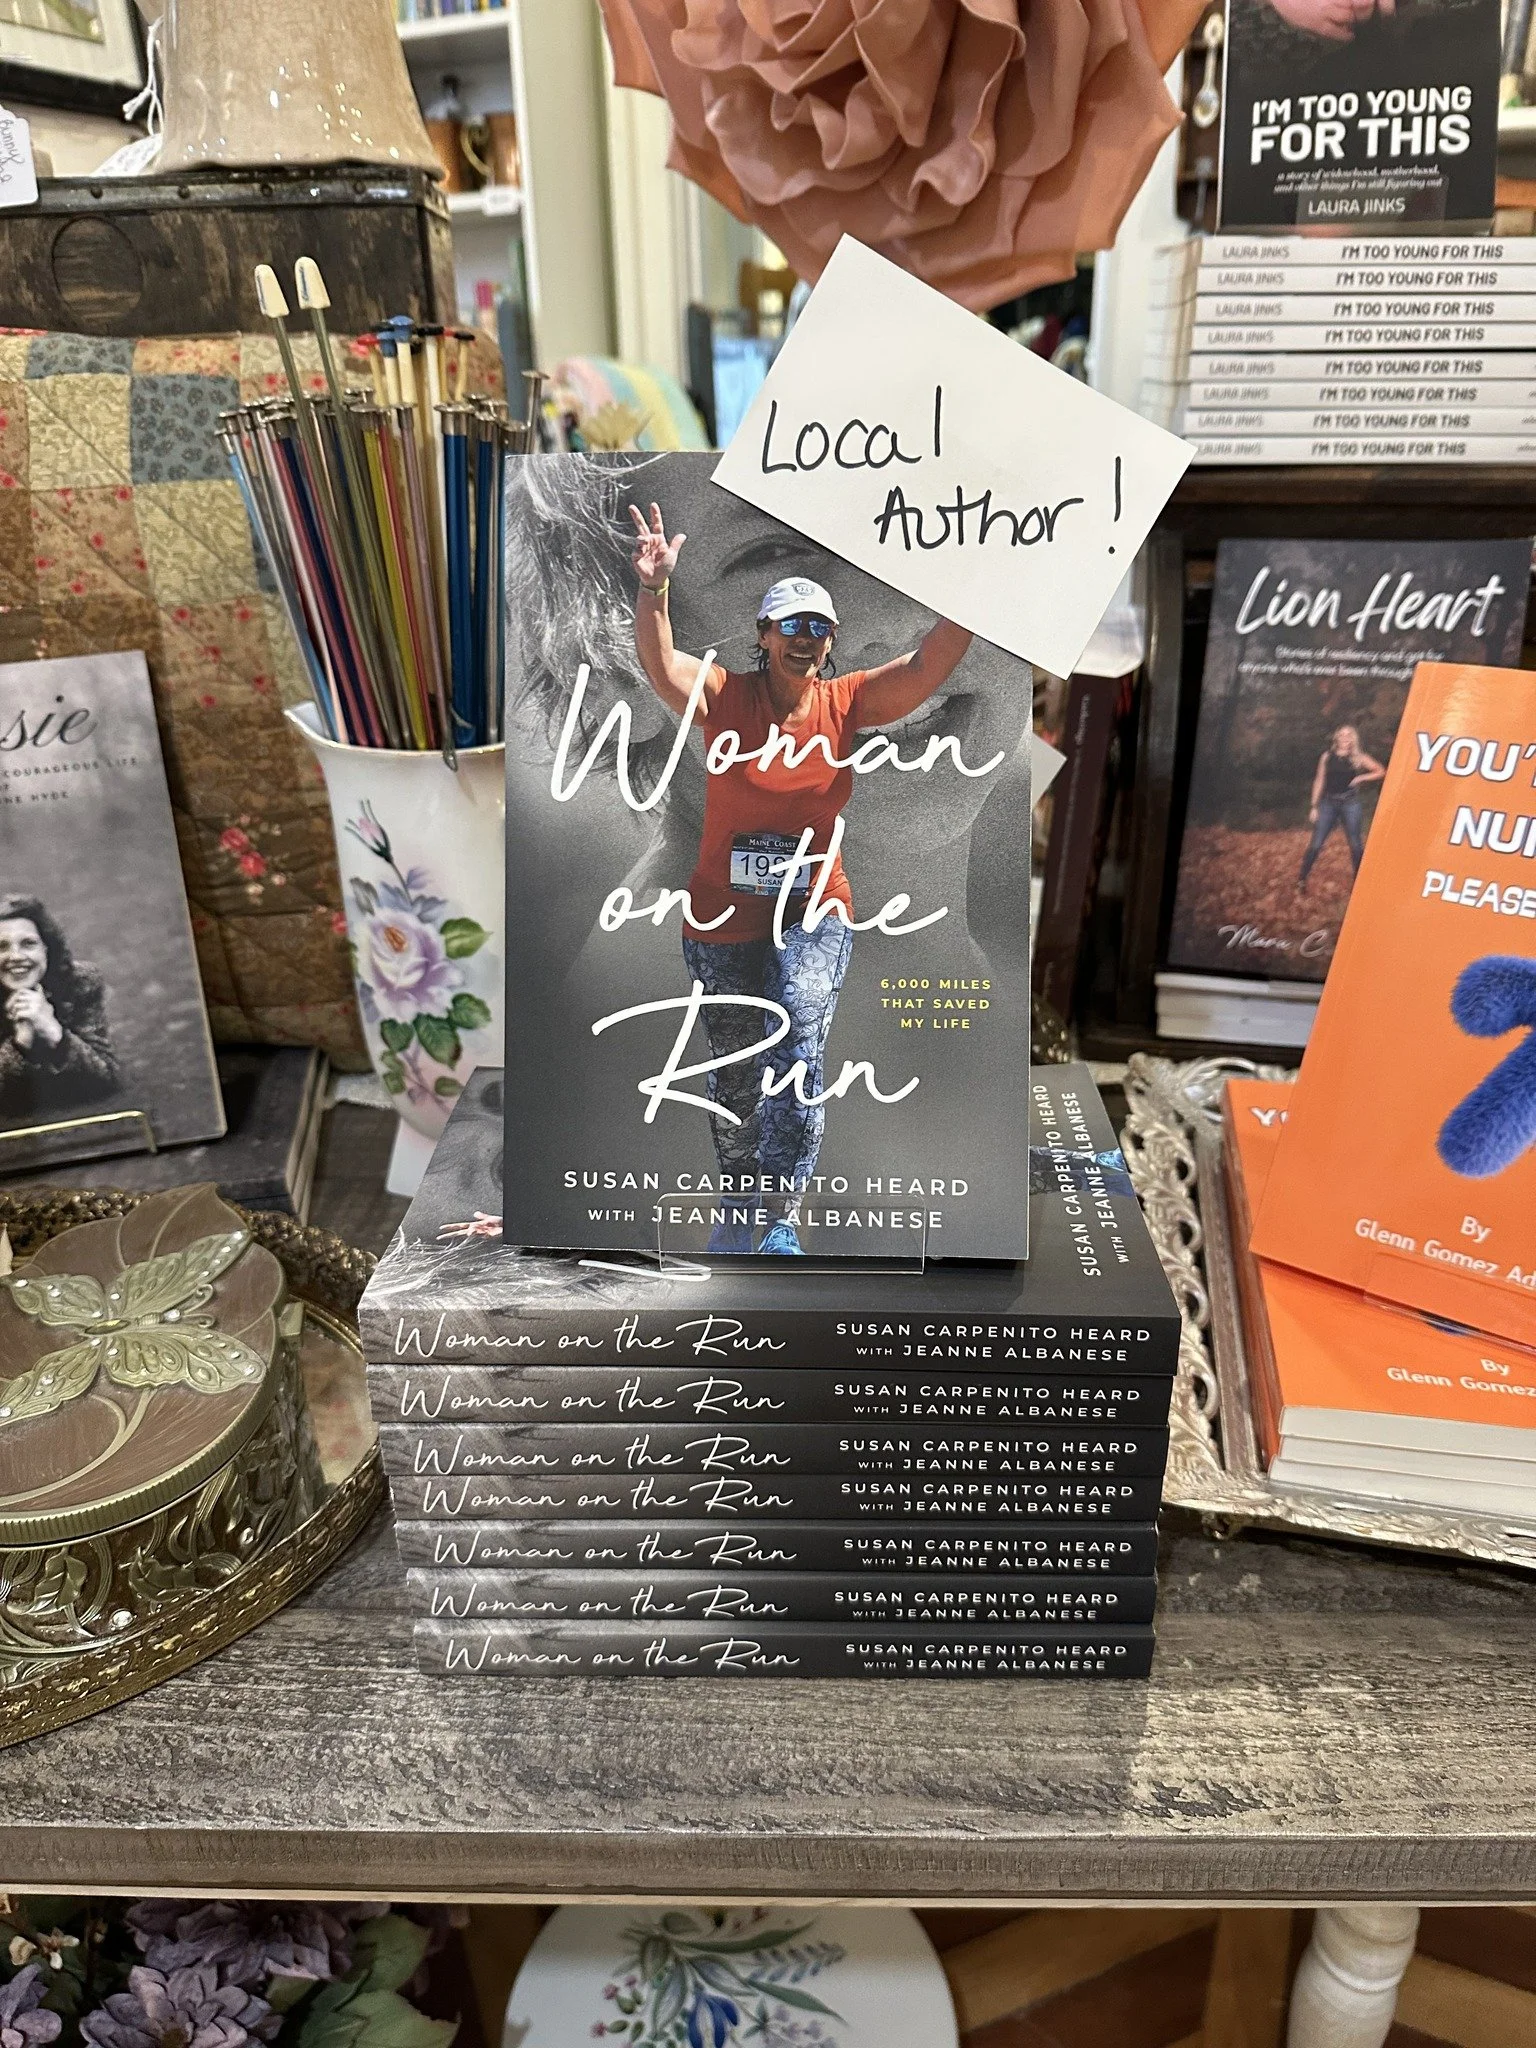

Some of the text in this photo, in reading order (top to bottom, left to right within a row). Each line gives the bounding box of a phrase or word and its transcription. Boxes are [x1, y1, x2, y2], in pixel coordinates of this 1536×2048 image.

[1253, 85, 1472, 126] I'M TOO YOUNG
[1250, 113, 1471, 165] FOR THIS
[1308, 197, 1406, 216] LAURA JINKS
[1341, 244, 1503, 259] I'M TOO YOUNG FOR THIS
[1336, 271, 1497, 286] I'M TOO YOUNG FOR THIS
[762, 385, 941, 473] Local
[873, 485, 1083, 551] Author
[1235, 565, 1505, 642] Lion Heart
[549, 648, 1005, 811] Woman
[1416, 732, 1536, 788] YOU'
[599, 815, 949, 951] on the
[881, 977, 992, 991] 6,000 MILES
[881, 997, 991, 1010] THAT SAVED
[901, 1018, 971, 1029] MY LIFE
[591, 979, 920, 1127] Run
[563, 1171, 969, 1197] SUSAN CARPENITO HEARD
[1033, 1085, 1101, 1276] SUSAN CARPENITO HEARD
[1061, 1092, 1129, 1263] WITH JEANNE ALBANESE
[587, 1204, 943, 1229] WITH JEANNE ALBANESE
[1460, 1216, 1491, 1243] By
[1355, 1218, 1416, 1251] Glenn
[1423, 1239, 1499, 1275] Gomez
[394, 1312, 785, 1357] Woman on the Run
[836, 1323, 1150, 1342] SUSAN CARPENITO HEARD
[856, 1344, 1128, 1362] WITH JEANNE ALBANESE
[1481, 1358, 1510, 1376] By
[834, 1384, 1140, 1401] SUSAN CARPENITO HEARD
[1387, 1367, 1536, 1397] Glenn Gomez
[400, 1374, 786, 1419] Woman on the Run
[899, 1404, 987, 1415] JEANNE
[998, 1405, 1118, 1418] ALBANESE
[413, 1433, 792, 1475] Woman on the Run
[839, 1439, 1138, 1454] SUSAN CARPENITO HEARD
[858, 1459, 1115, 1472] WITH JEANNE ALBANESE
[421, 1475, 794, 1515] Woman on the Run
[841, 1483, 1133, 1496] SUSAN CARPENITO HEARD
[859, 1501, 1112, 1513] WITH JEANNE ALBANESE
[433, 1531, 797, 1566] Woman on the Run
[843, 1539, 1132, 1552] SUSAN CARPENITO HEARD
[862, 1556, 1110, 1568] WITH JEANNE ALBANESE
[430, 1584, 788, 1618] Woman on the Run
[834, 1591, 1119, 1604] SUSAN CARPENITO HEARD
[852, 1608, 1097, 1619] WITH JEANNE ALBANESE
[445, 1635, 800, 1672] Woman on the Run
[845, 1643, 1127, 1655] SUSAN CARPENITO HEARD
[906, 1659, 987, 1669] JEANNE
[997, 1660, 1106, 1670] ALBANESE
